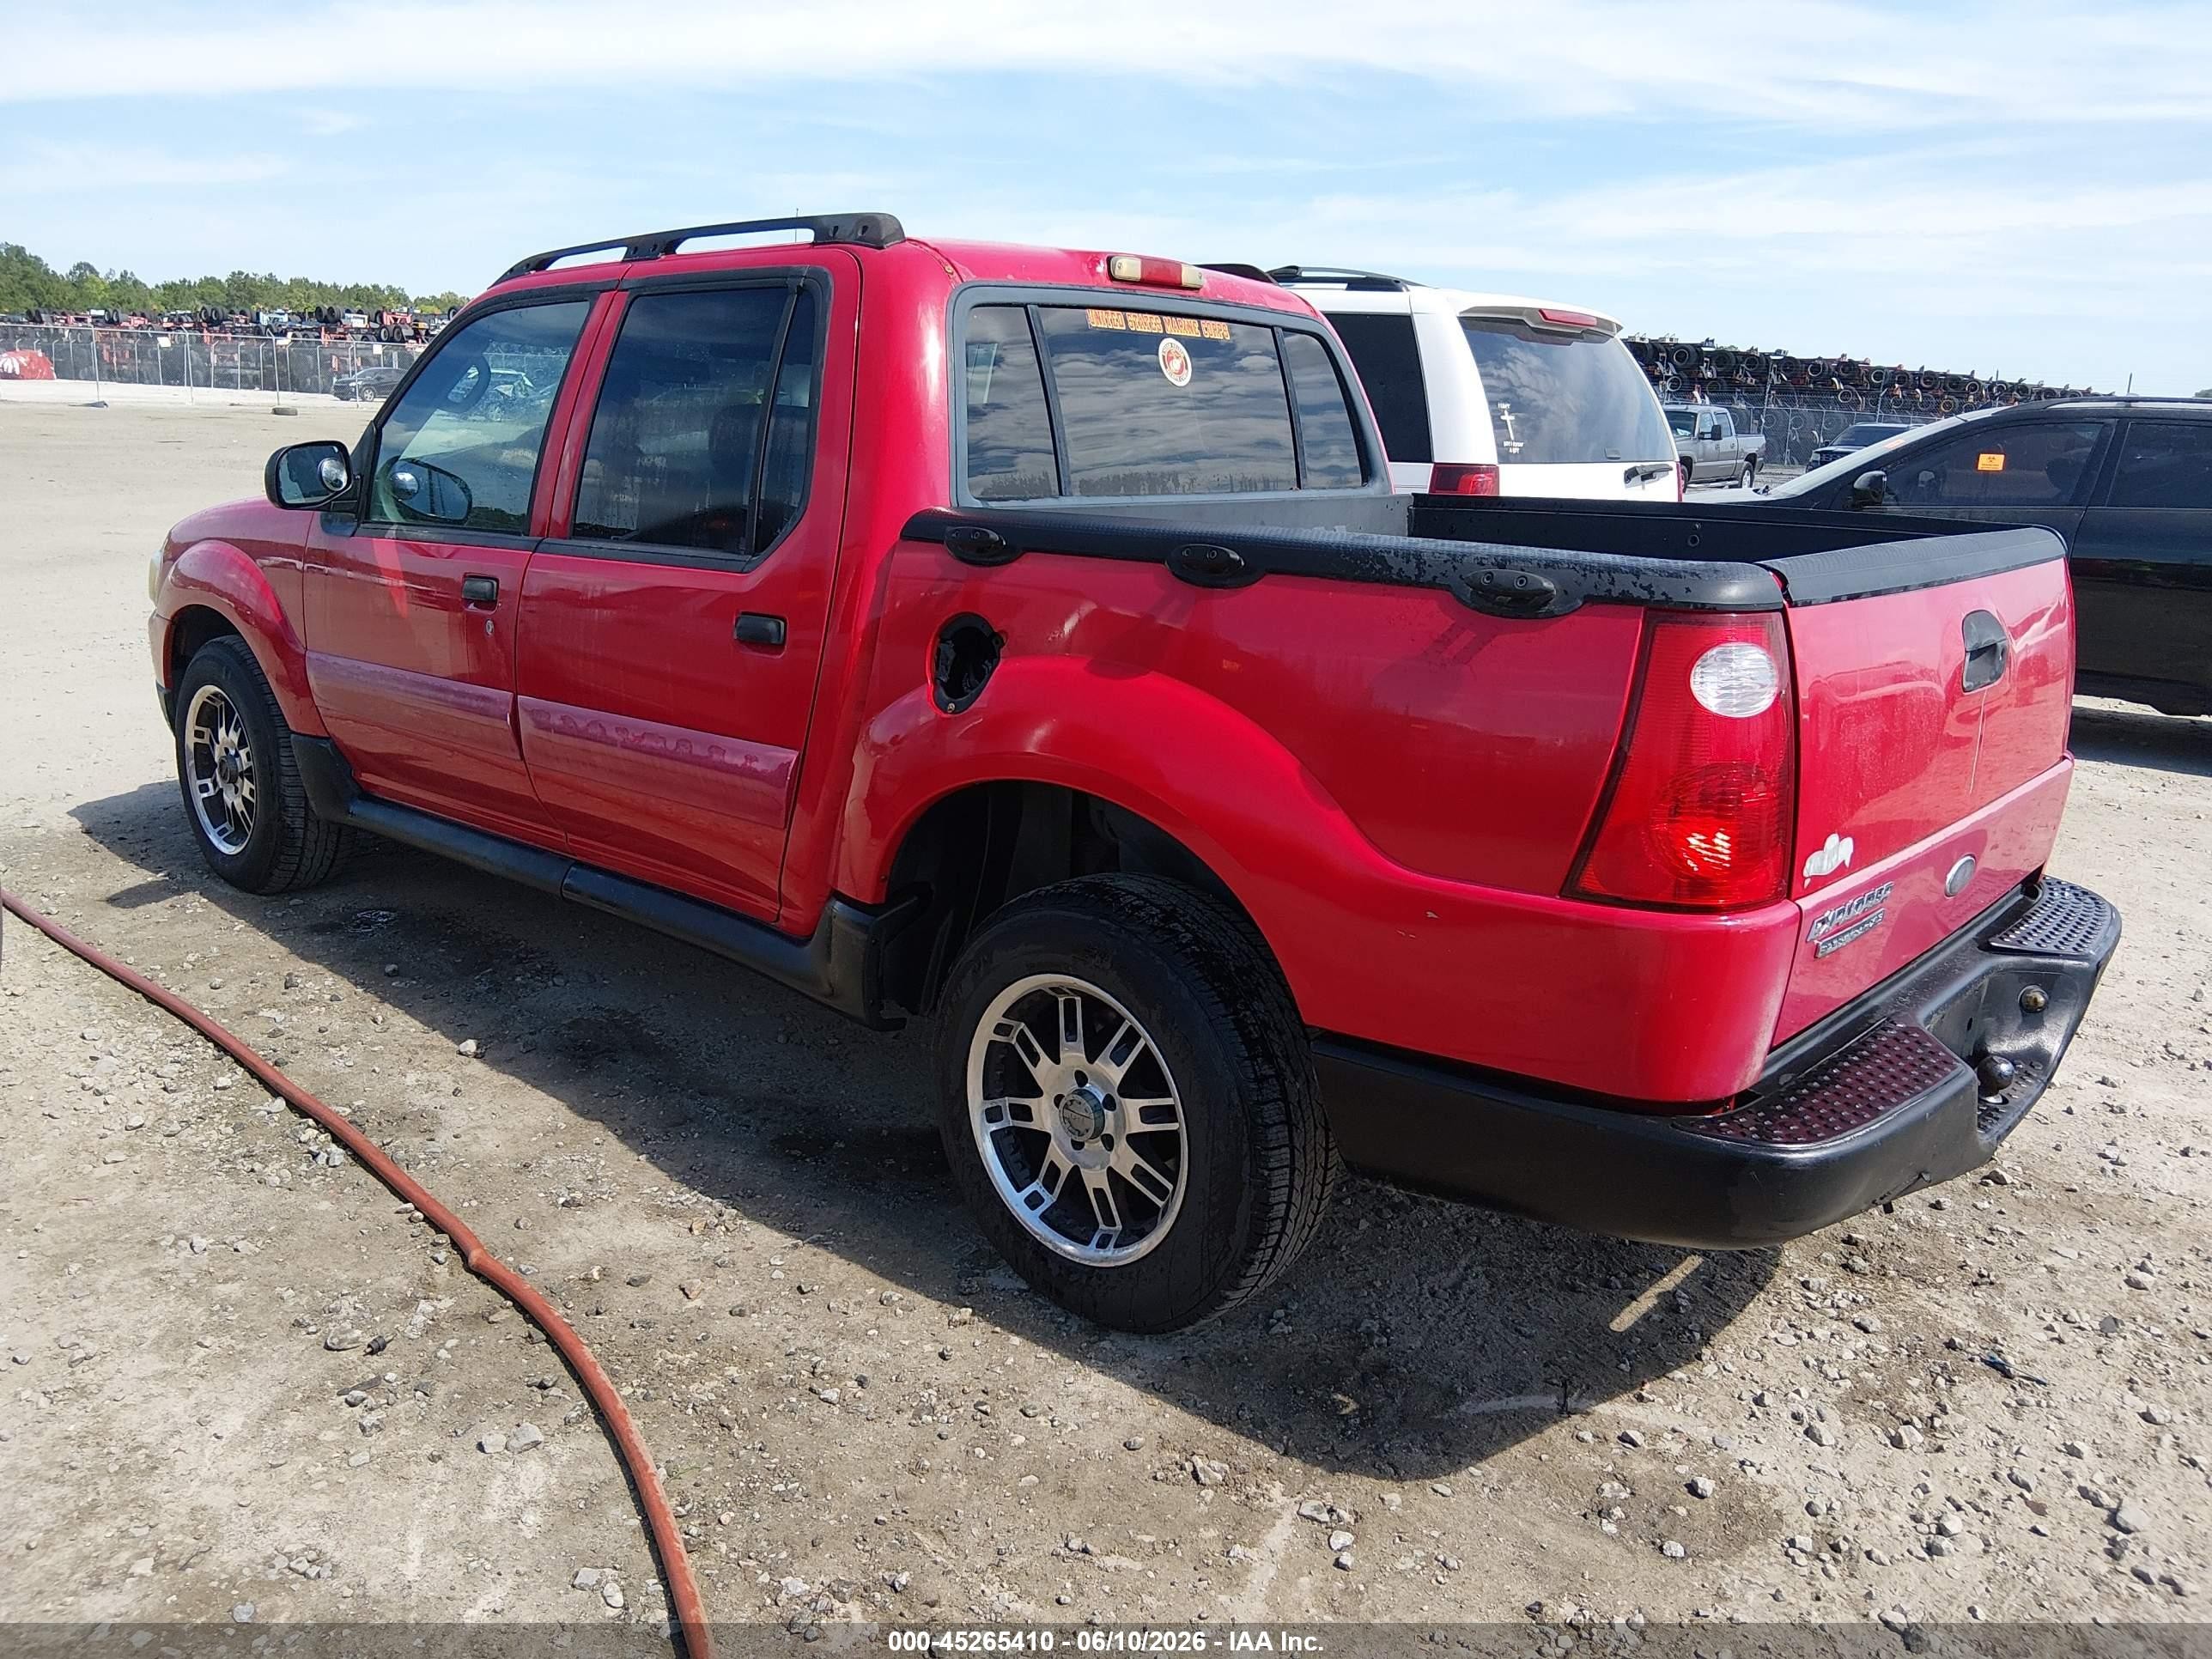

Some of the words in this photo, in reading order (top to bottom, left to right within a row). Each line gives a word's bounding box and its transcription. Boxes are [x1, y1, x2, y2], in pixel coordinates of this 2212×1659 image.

[1086, 309, 1126, 330] UNITED
[1126, 313, 1164, 333] STATES
[1163, 316, 1201, 337] MARINE
[1200, 320, 1230, 340] CORPS
